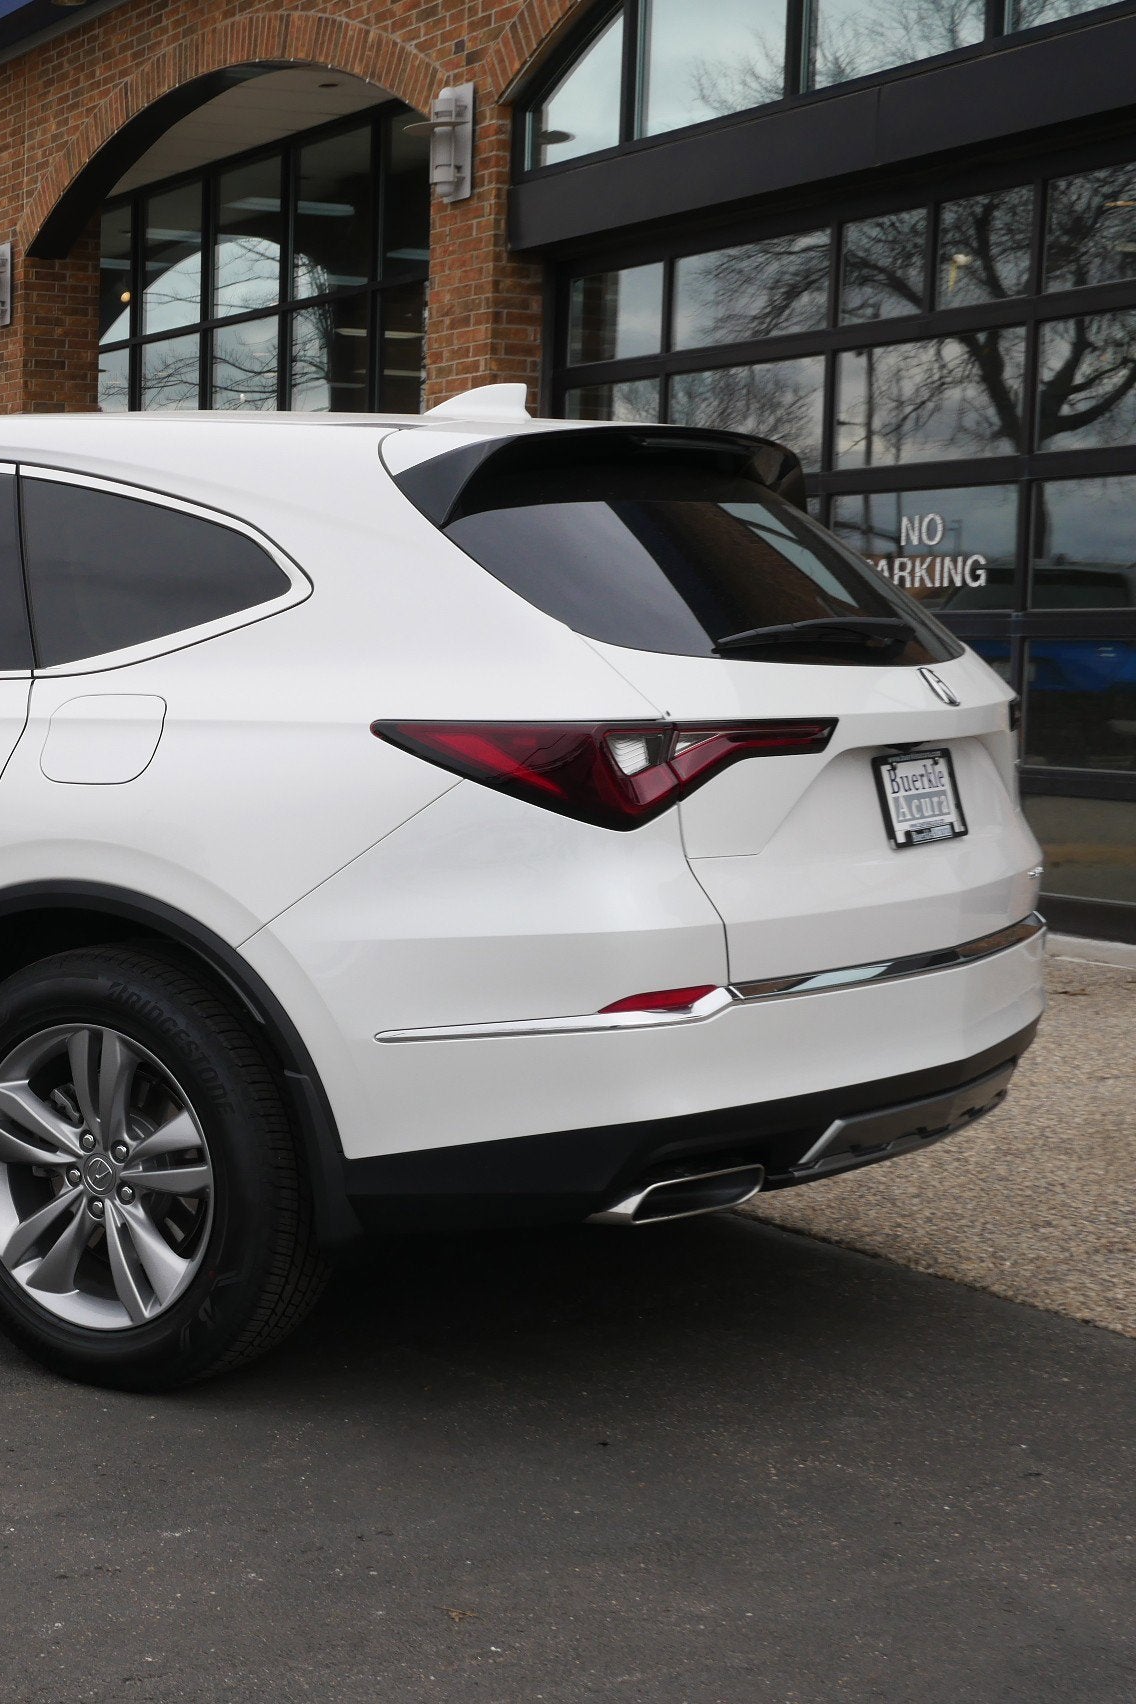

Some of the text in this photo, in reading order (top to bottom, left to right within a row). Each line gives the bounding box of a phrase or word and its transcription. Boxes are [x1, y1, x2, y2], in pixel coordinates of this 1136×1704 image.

[900, 513, 944, 546] NO
[865, 554, 987, 588] ARKING
[886, 762, 945, 794] Buerkle
[897, 795, 951, 821] Acura
[106, 980, 237, 1116] BRIDGESTONE
